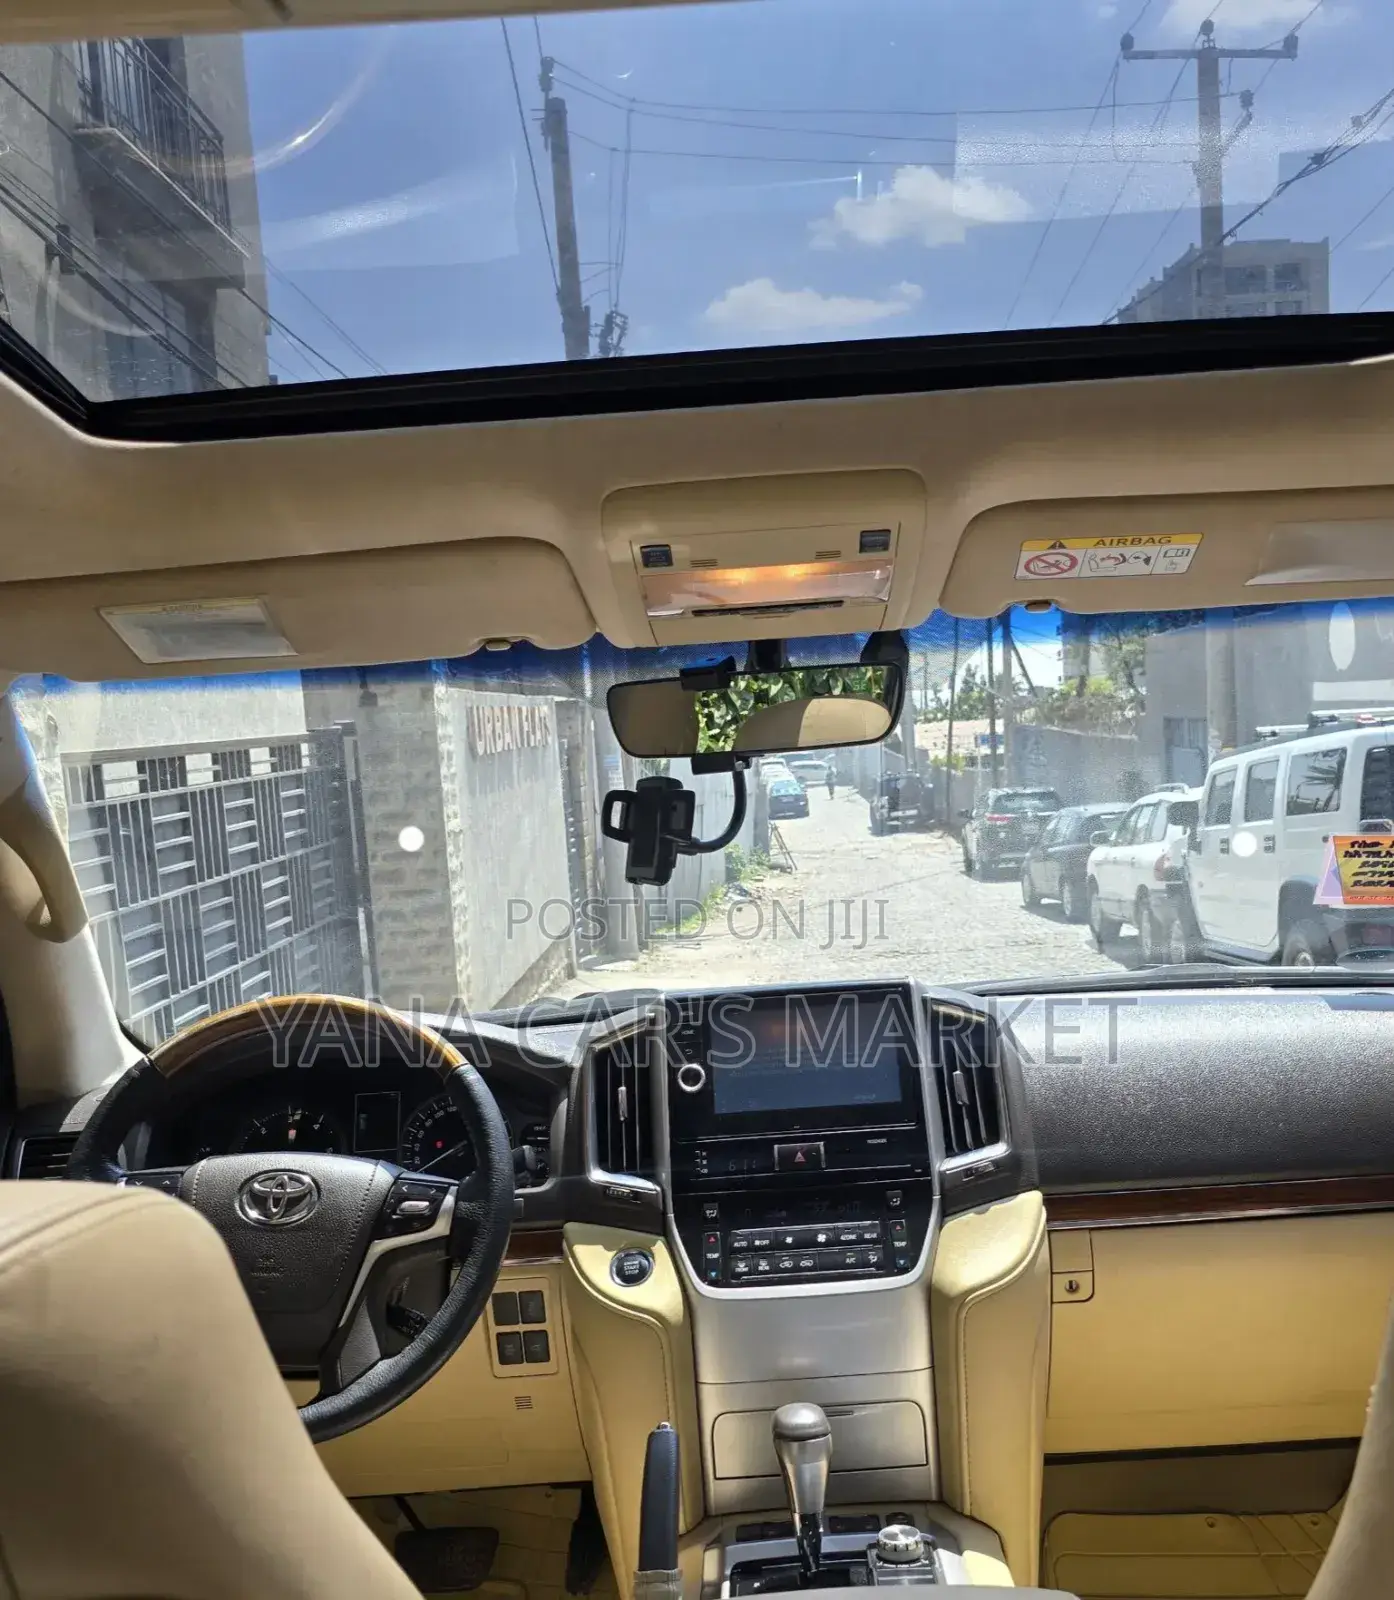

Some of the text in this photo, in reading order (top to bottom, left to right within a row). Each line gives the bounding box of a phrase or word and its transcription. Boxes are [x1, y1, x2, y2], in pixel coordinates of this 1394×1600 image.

[1093, 536, 1172, 547] AIRBAG
[472, 704, 521, 756] URBAN
[260, 1126, 268, 1136] 2
[312, 1123, 321, 1131] 4
